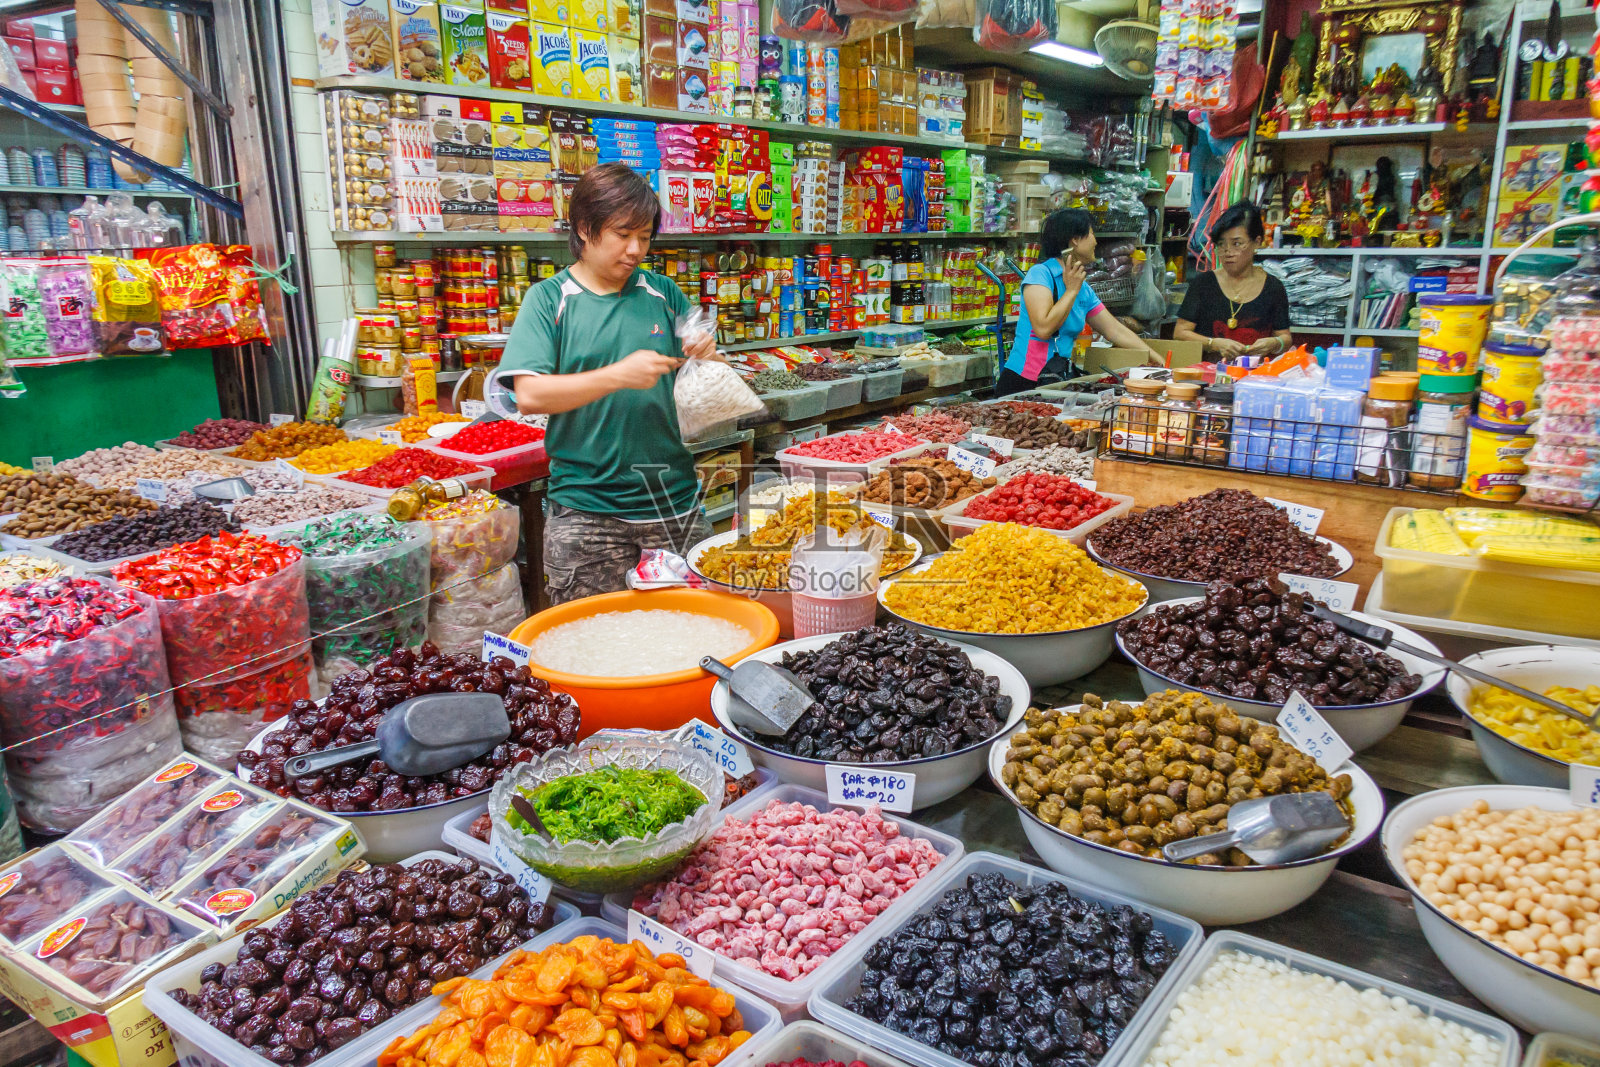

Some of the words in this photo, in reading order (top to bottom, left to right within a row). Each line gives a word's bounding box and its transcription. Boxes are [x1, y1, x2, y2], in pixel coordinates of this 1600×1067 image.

[496, 35, 508, 56] 3
[506, 40, 526, 49] SEEDS
[732, 151, 742, 162] RITZ
[717, 187, 727, 199] RITZ
[757, 189, 772, 206] RITZ
[970, 465, 988, 478] 220
[1487, 473, 1522, 481] Prun
[1320, 582, 1337, 594] 20
[721, 738, 737, 756] 20
[1320, 732, 1334, 745] 15
[1305, 738, 1323, 758] 120
[715, 751, 737, 772] 180
[881, 776, 906, 790] 180
[878, 792, 896, 803] 20
[675, 940, 694, 958] 20
[134, 1013, 158, 1031] LASSE
[150, 1022, 168, 1039] ET
[145, 1039, 165, 1058] KG
